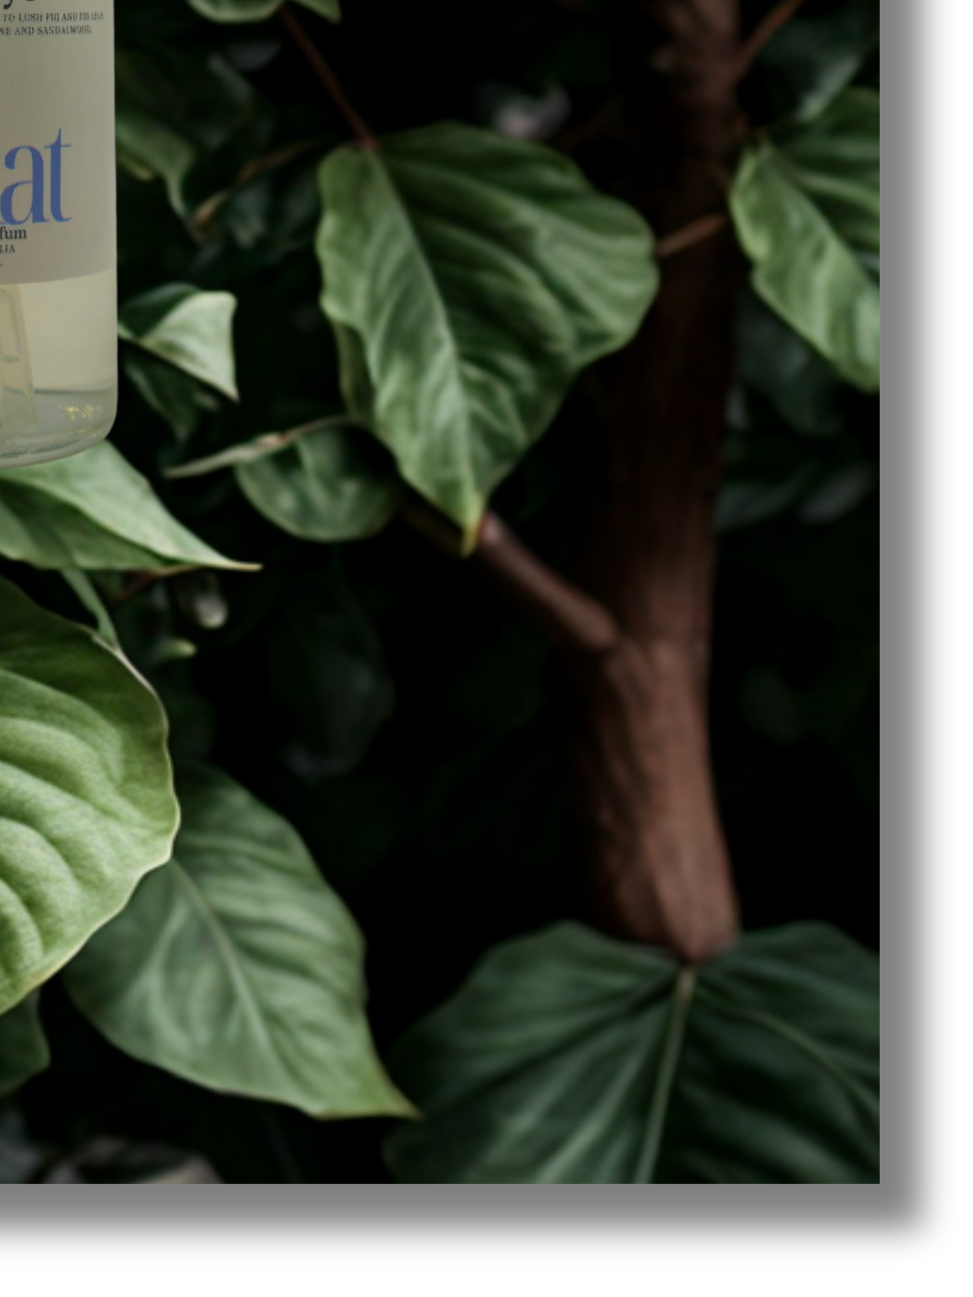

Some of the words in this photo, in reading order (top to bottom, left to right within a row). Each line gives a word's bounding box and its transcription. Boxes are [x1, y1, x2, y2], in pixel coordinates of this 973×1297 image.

[2, 13, 16, 23] TO
[19, 13, 43, 22] LUSH
[45, 12, 60, 22] FIG
[61, 12, 78, 21] AND
[79, 11, 90, 21] FIG
[14, 26, 35, 35] AND
